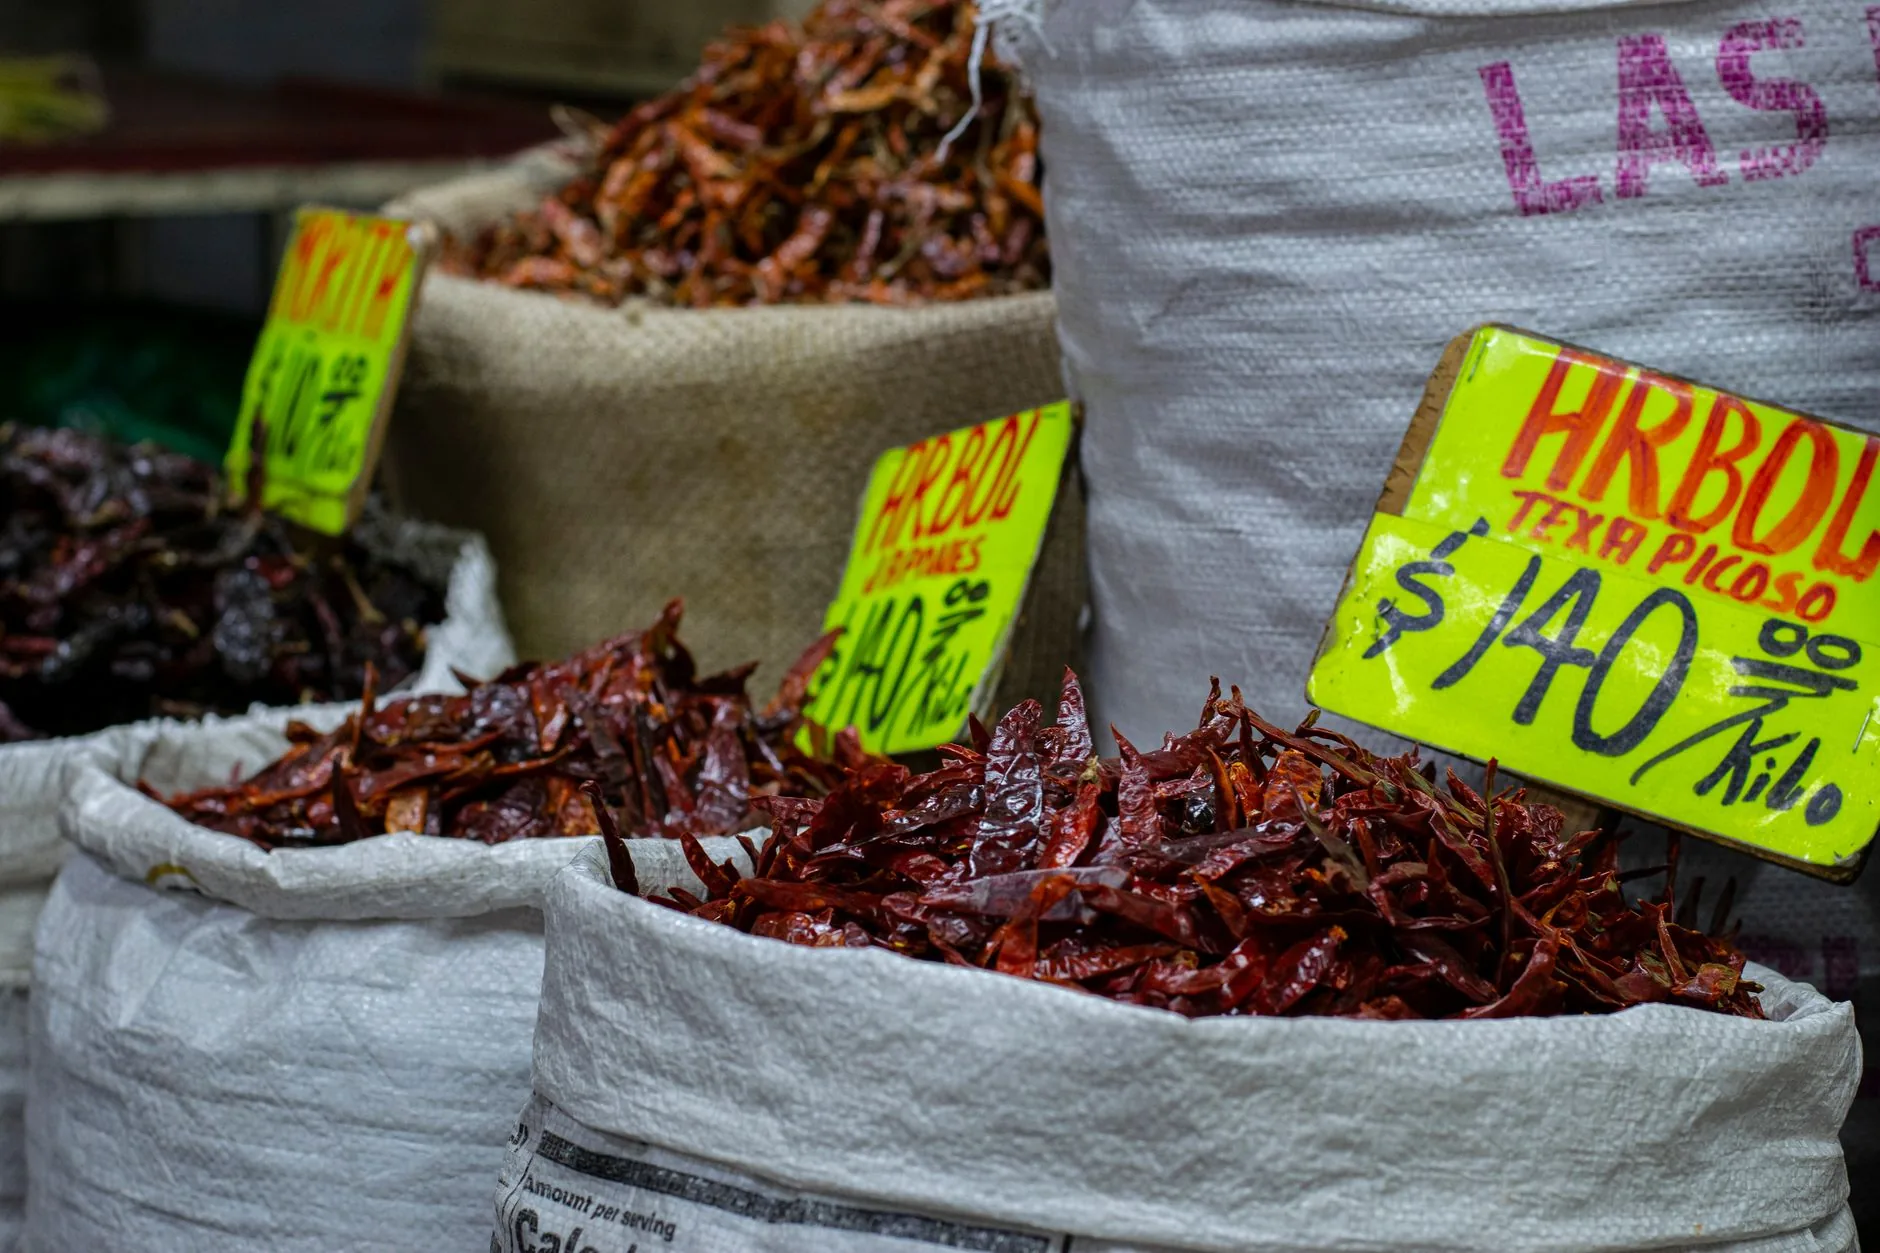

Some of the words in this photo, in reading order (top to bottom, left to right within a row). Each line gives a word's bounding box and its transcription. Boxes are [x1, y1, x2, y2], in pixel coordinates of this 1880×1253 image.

[1478, 17, 1829, 217] LAS
[1506, 490, 1648, 564] TEXA
[1647, 533, 1838, 624] PICOSO
[1758, 618, 1862, 670] 00
[523, 1173, 593, 1213] Amount
[591, 1202, 619, 1221] per
